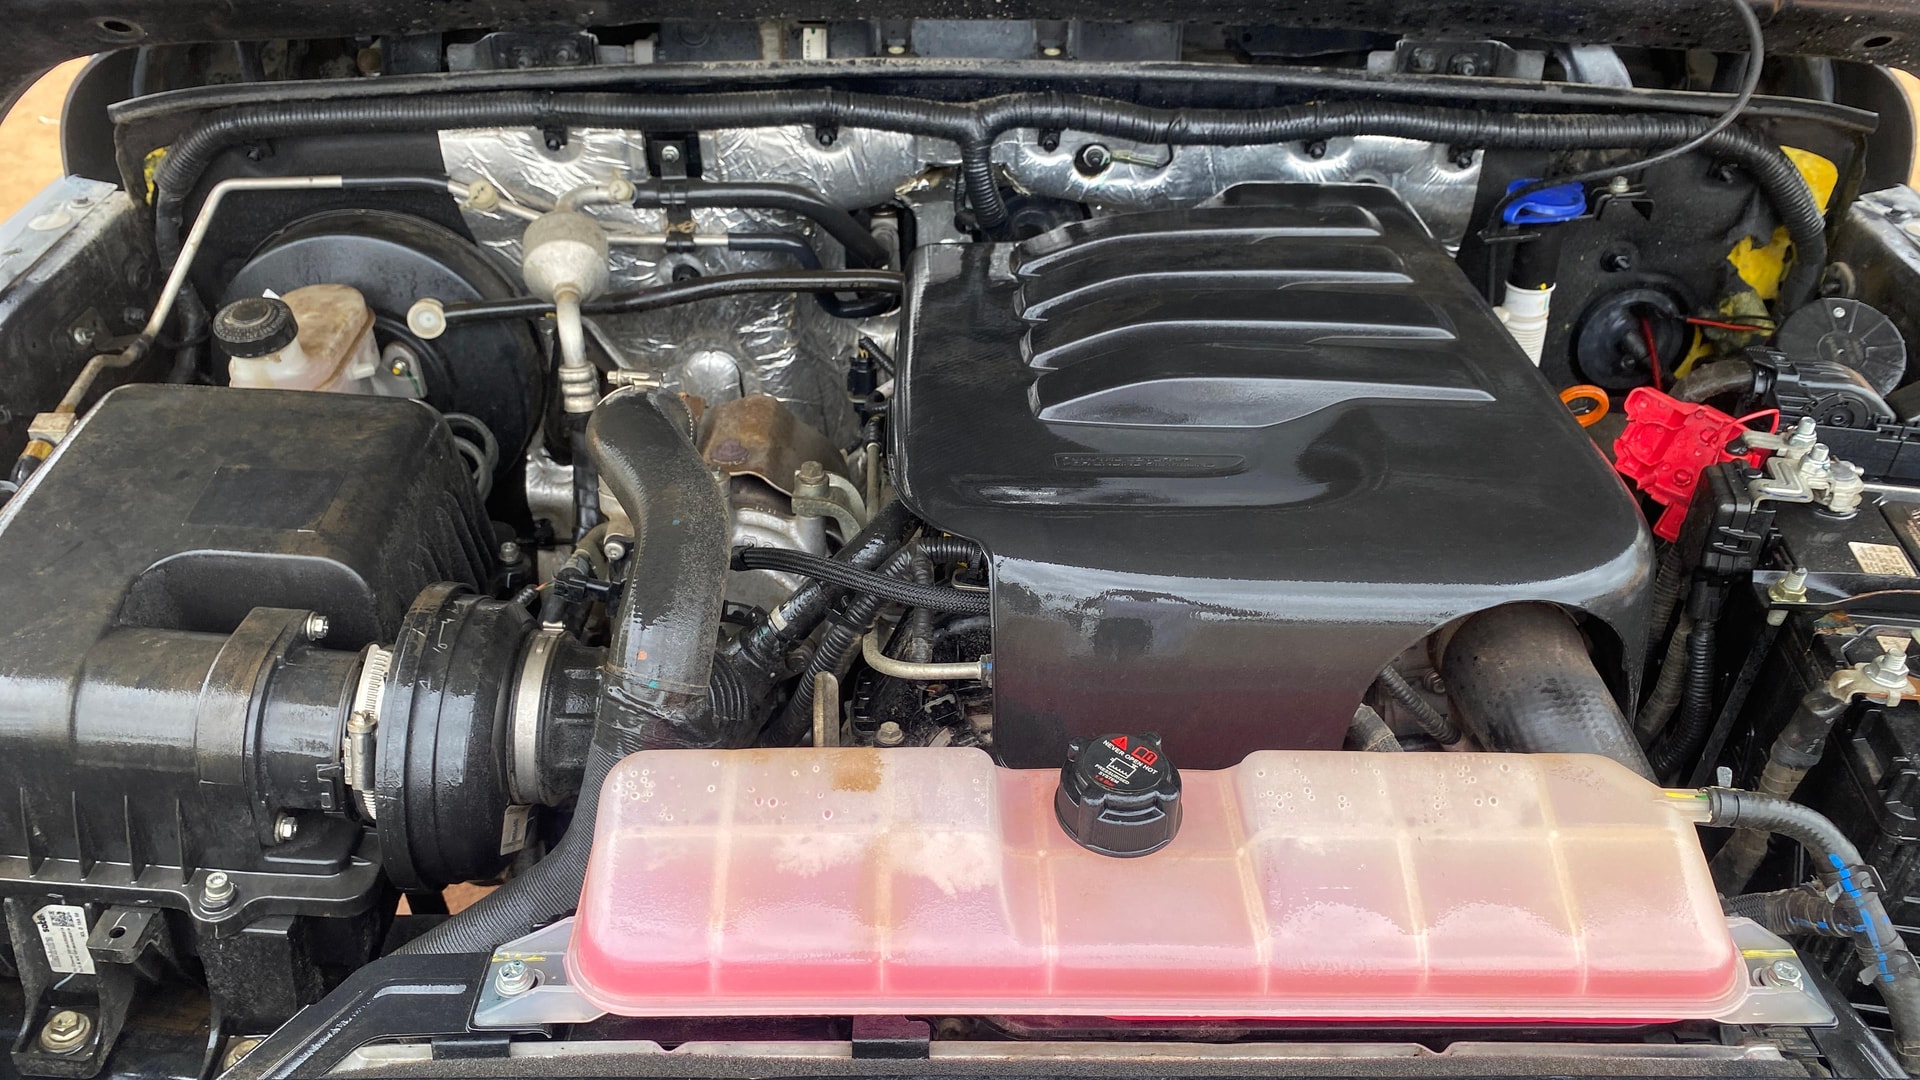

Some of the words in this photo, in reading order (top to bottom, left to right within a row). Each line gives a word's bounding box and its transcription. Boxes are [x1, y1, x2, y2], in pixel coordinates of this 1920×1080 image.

[1103, 740, 1125, 756] NEVER
[1124, 754, 1144, 767] OPEN
[1142, 764, 1158, 774] HOT
[1095, 764, 1129, 784] PRESSURISED
[1098, 771, 1119, 784] SYSTEM
